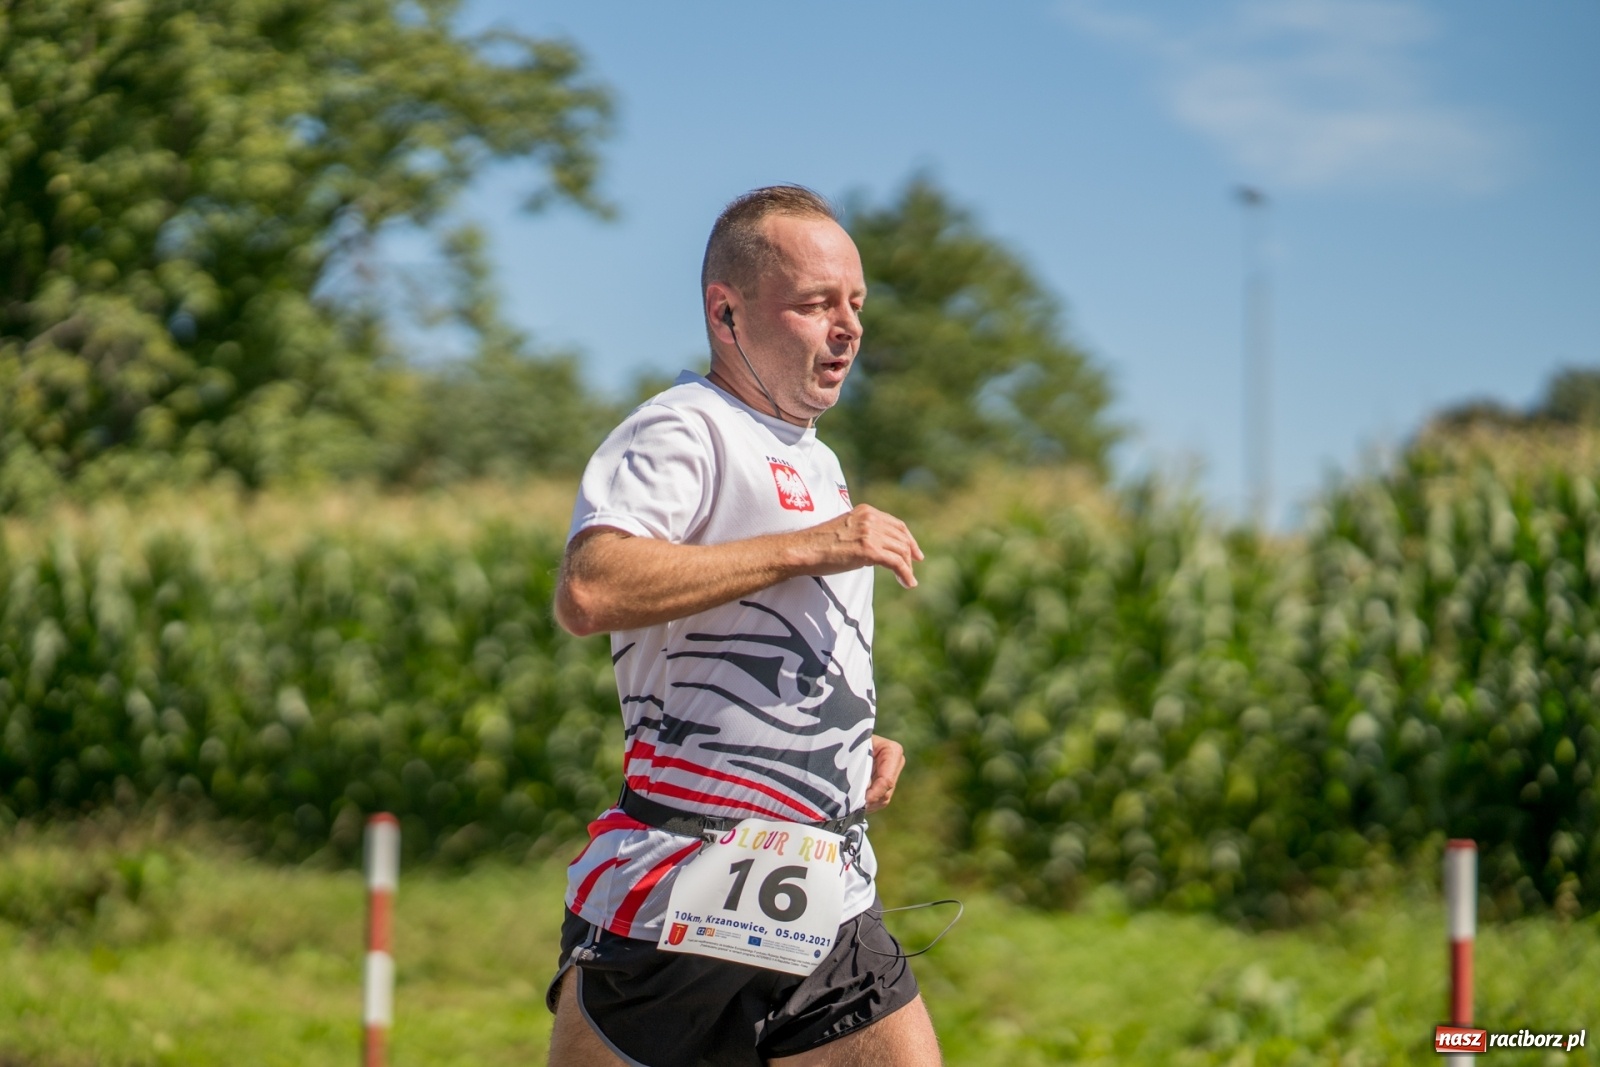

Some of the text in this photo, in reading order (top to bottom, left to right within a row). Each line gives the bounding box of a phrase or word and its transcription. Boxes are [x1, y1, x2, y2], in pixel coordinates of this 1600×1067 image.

[799, 836, 837, 864] RUN
[723, 858, 808, 922] 16
[675, 911, 702, 924] 10km,
[705, 915, 768, 935] Krzanowice,
[775, 928, 831, 947] 05.09.2021
